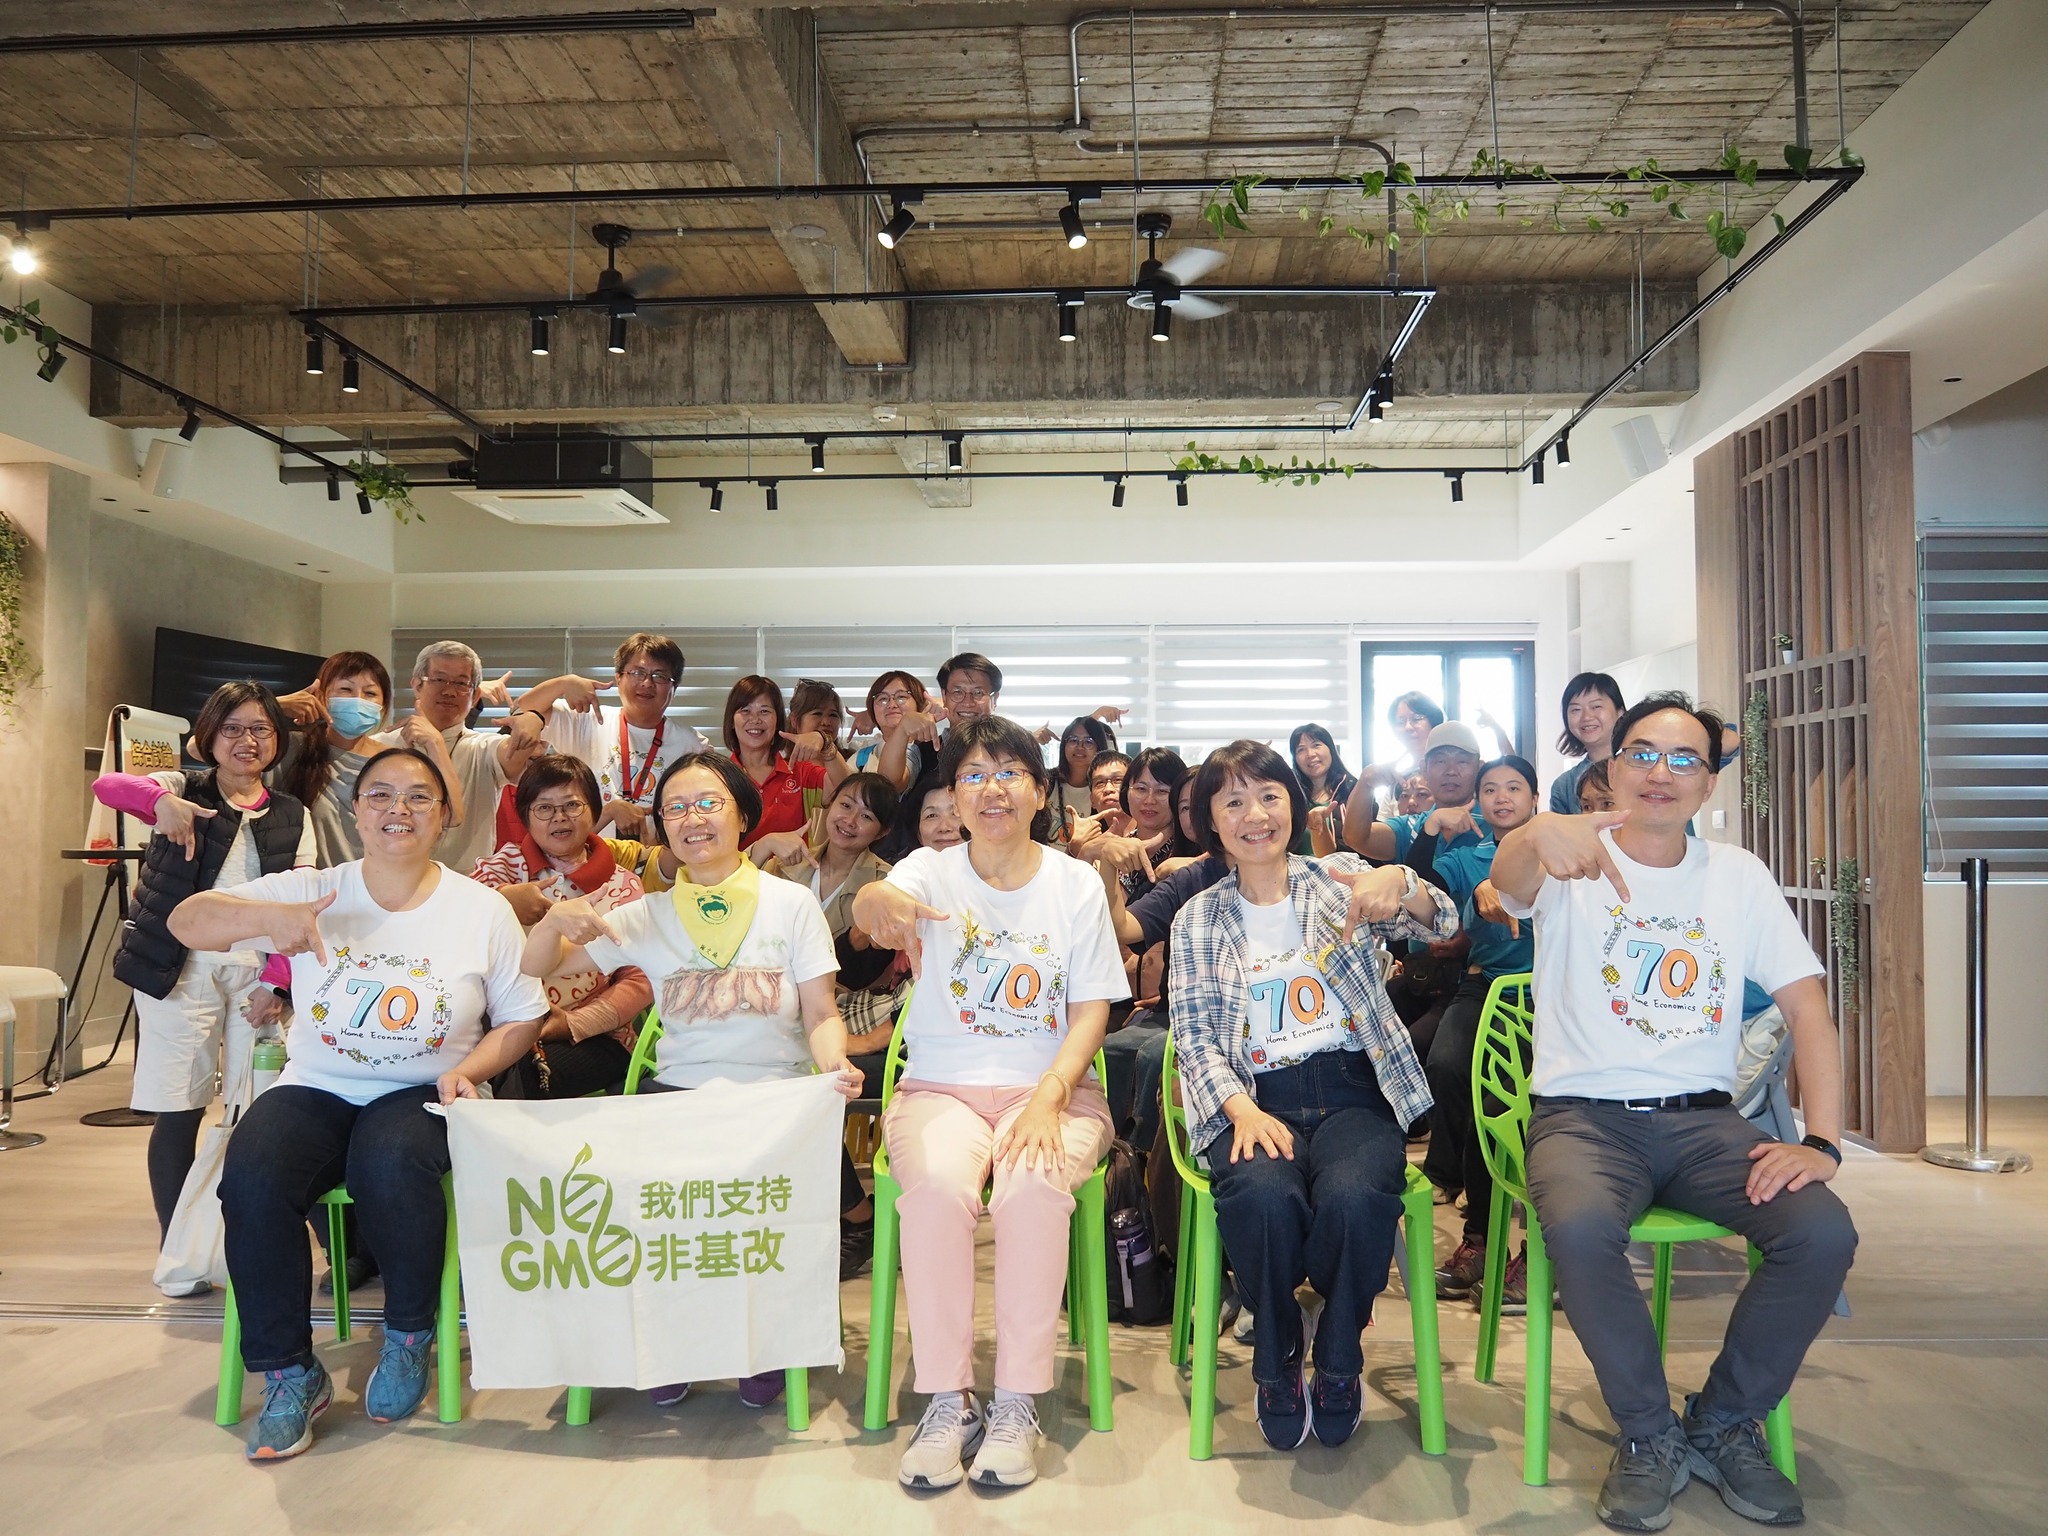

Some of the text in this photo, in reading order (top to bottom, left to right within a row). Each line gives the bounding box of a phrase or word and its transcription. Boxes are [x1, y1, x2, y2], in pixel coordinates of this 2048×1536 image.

[131, 739, 174, 769] 綜合討論
[977, 1002, 996, 1013] Home
[1653, 999, 1697, 1012] Economics
[340, 1027, 418, 1042] Home Economics
[1265, 1022, 1335, 1045] Home Economics
[639, 1174, 793, 1221] 我們支持
[501, 1224, 642, 1292] GMO
[646, 1227, 786, 1283] 非基改
